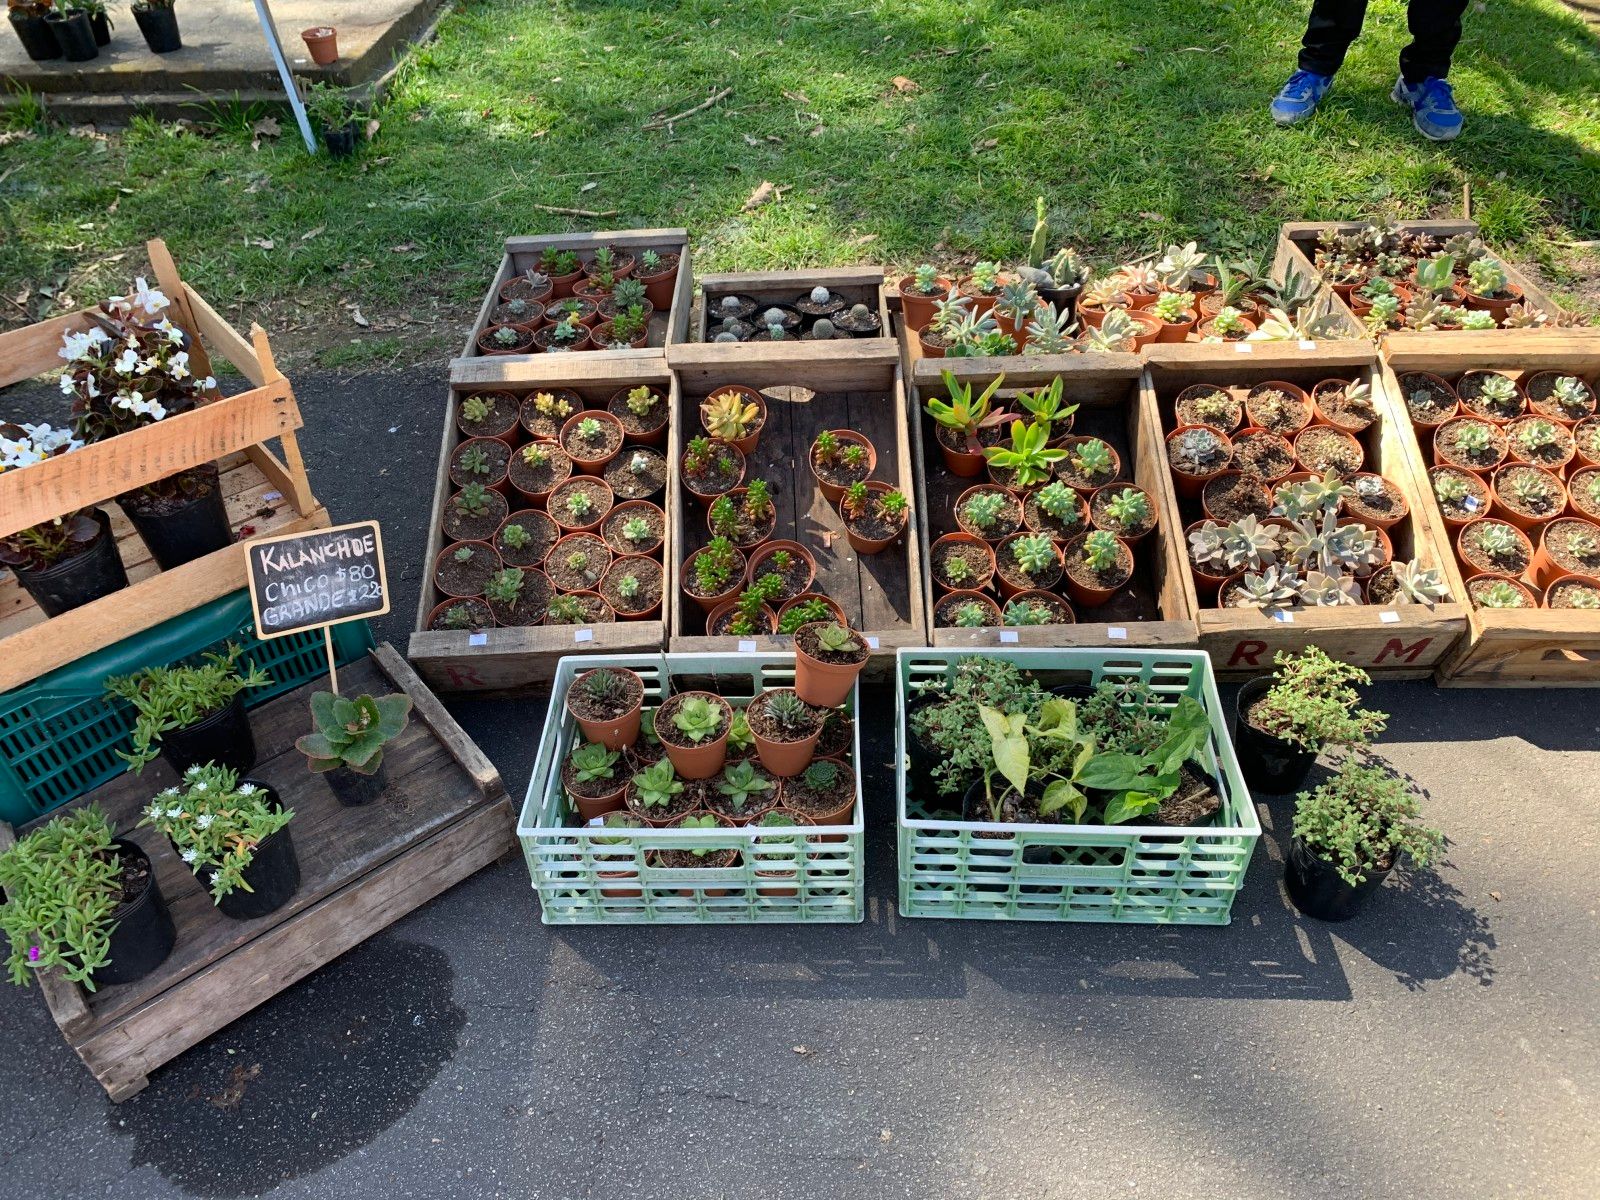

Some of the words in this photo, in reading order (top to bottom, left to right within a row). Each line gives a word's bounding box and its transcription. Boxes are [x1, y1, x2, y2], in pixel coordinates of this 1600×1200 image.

[259, 533, 375, 575] KALANCHOE
[336, 564, 375, 583] $80
[263, 589, 345, 626] GRANDE
[1226, 640, 1268, 666] R
[1372, 637, 1434, 664] M
